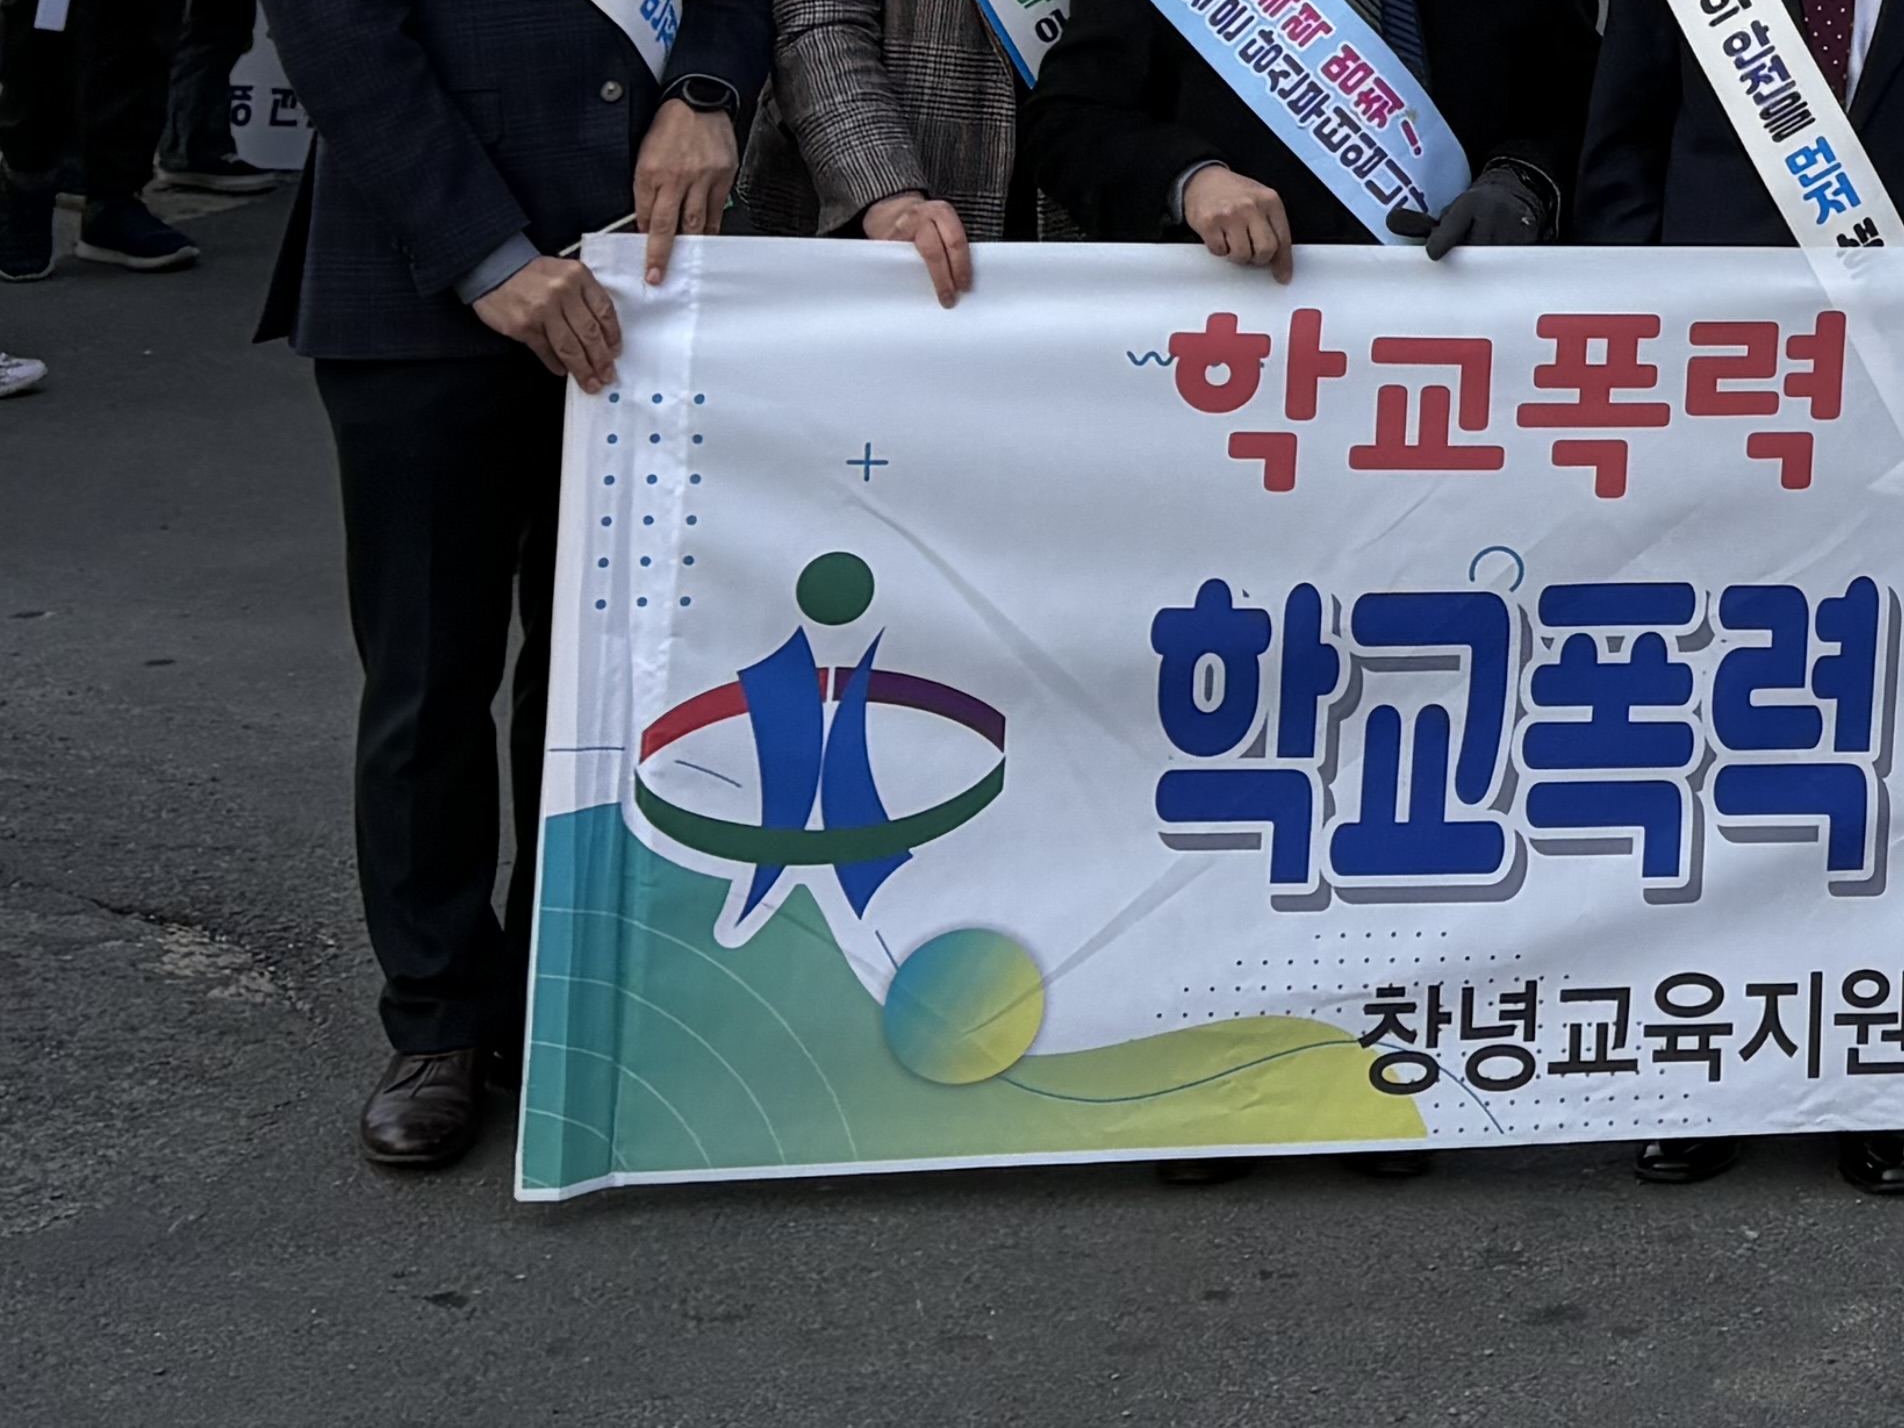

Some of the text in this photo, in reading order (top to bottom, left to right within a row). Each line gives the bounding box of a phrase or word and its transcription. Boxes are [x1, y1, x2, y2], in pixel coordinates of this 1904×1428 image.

[1722, 18, 1817, 143] 안전을
[1785, 136, 1862, 225] 먼저
[1167, 308, 1848, 498] 학교폭력
[1149, 576, 1888, 892] 학교폭력
